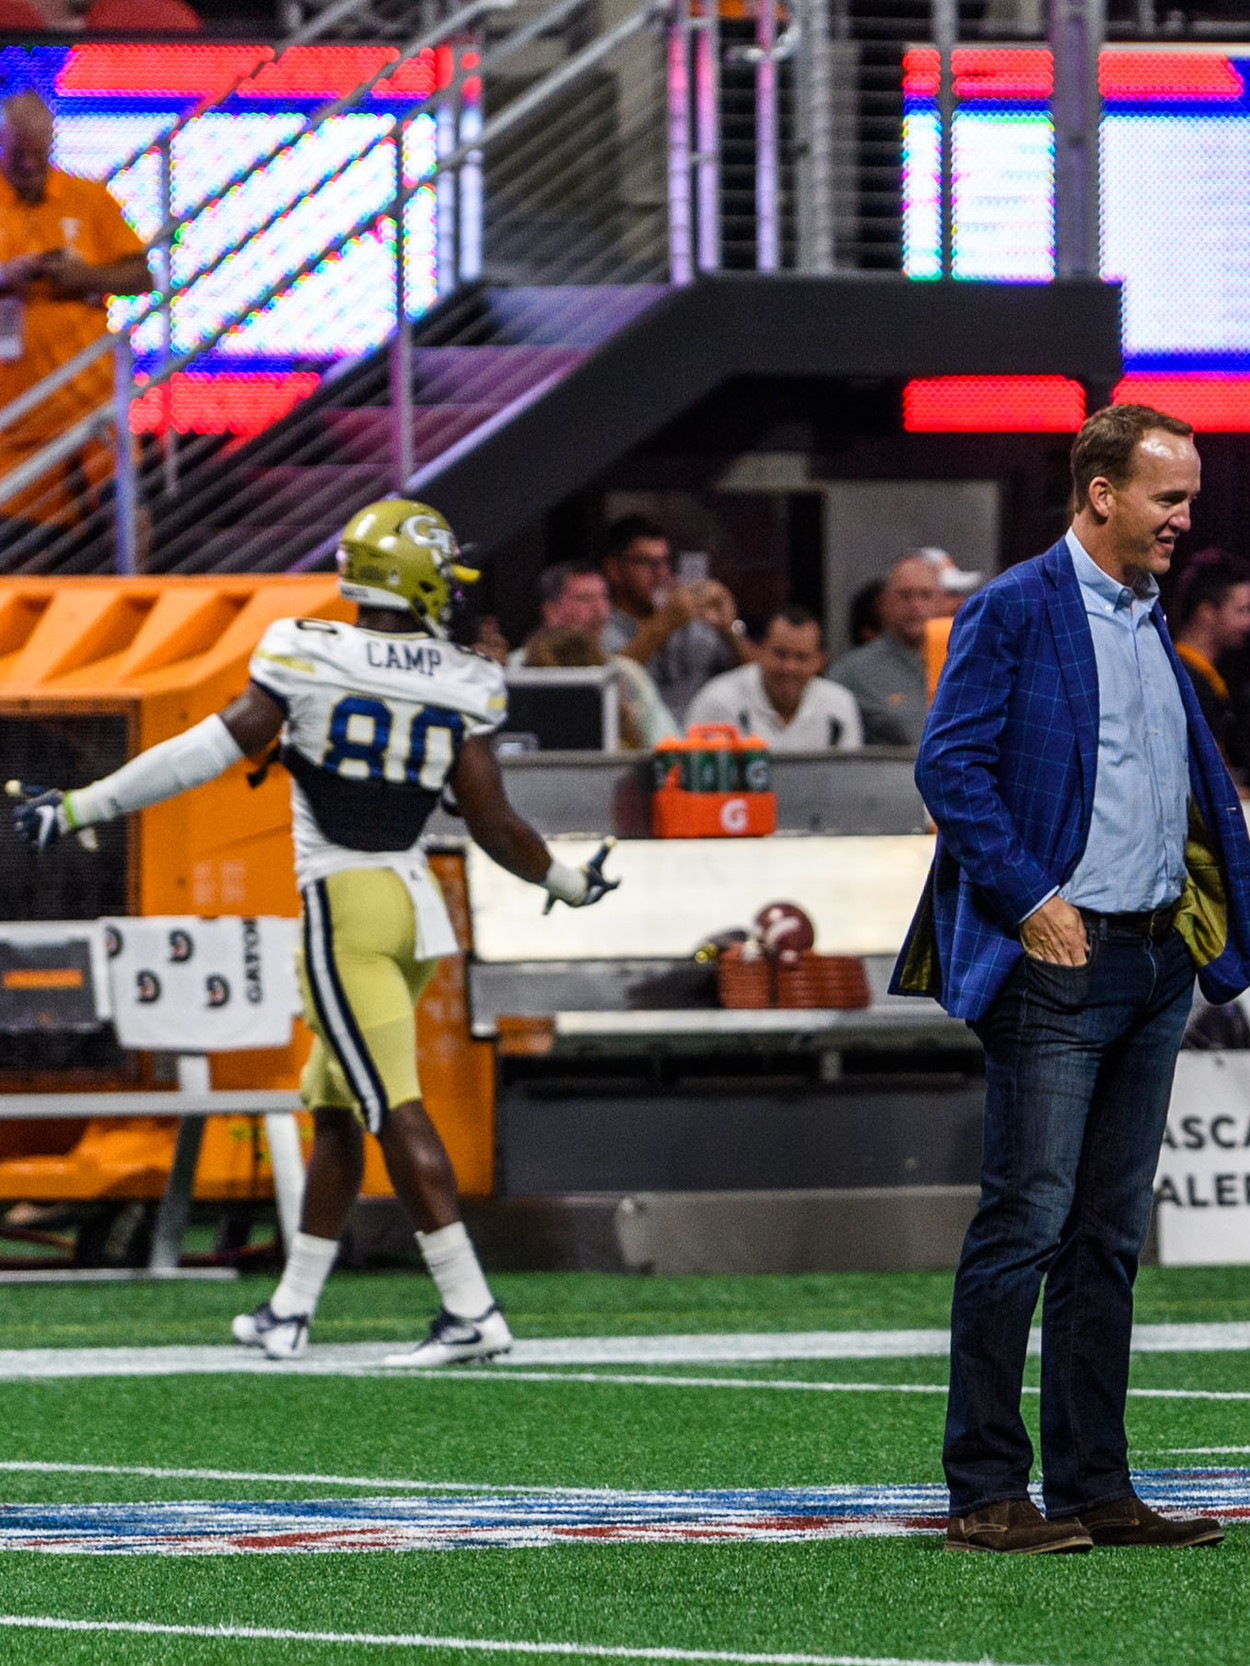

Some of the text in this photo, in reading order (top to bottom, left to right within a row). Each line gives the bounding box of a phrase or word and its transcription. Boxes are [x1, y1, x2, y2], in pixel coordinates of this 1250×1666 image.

[366, 640, 442, 676] CAMP
[319, 690, 465, 790] 80
[719, 798, 748, 834] G
